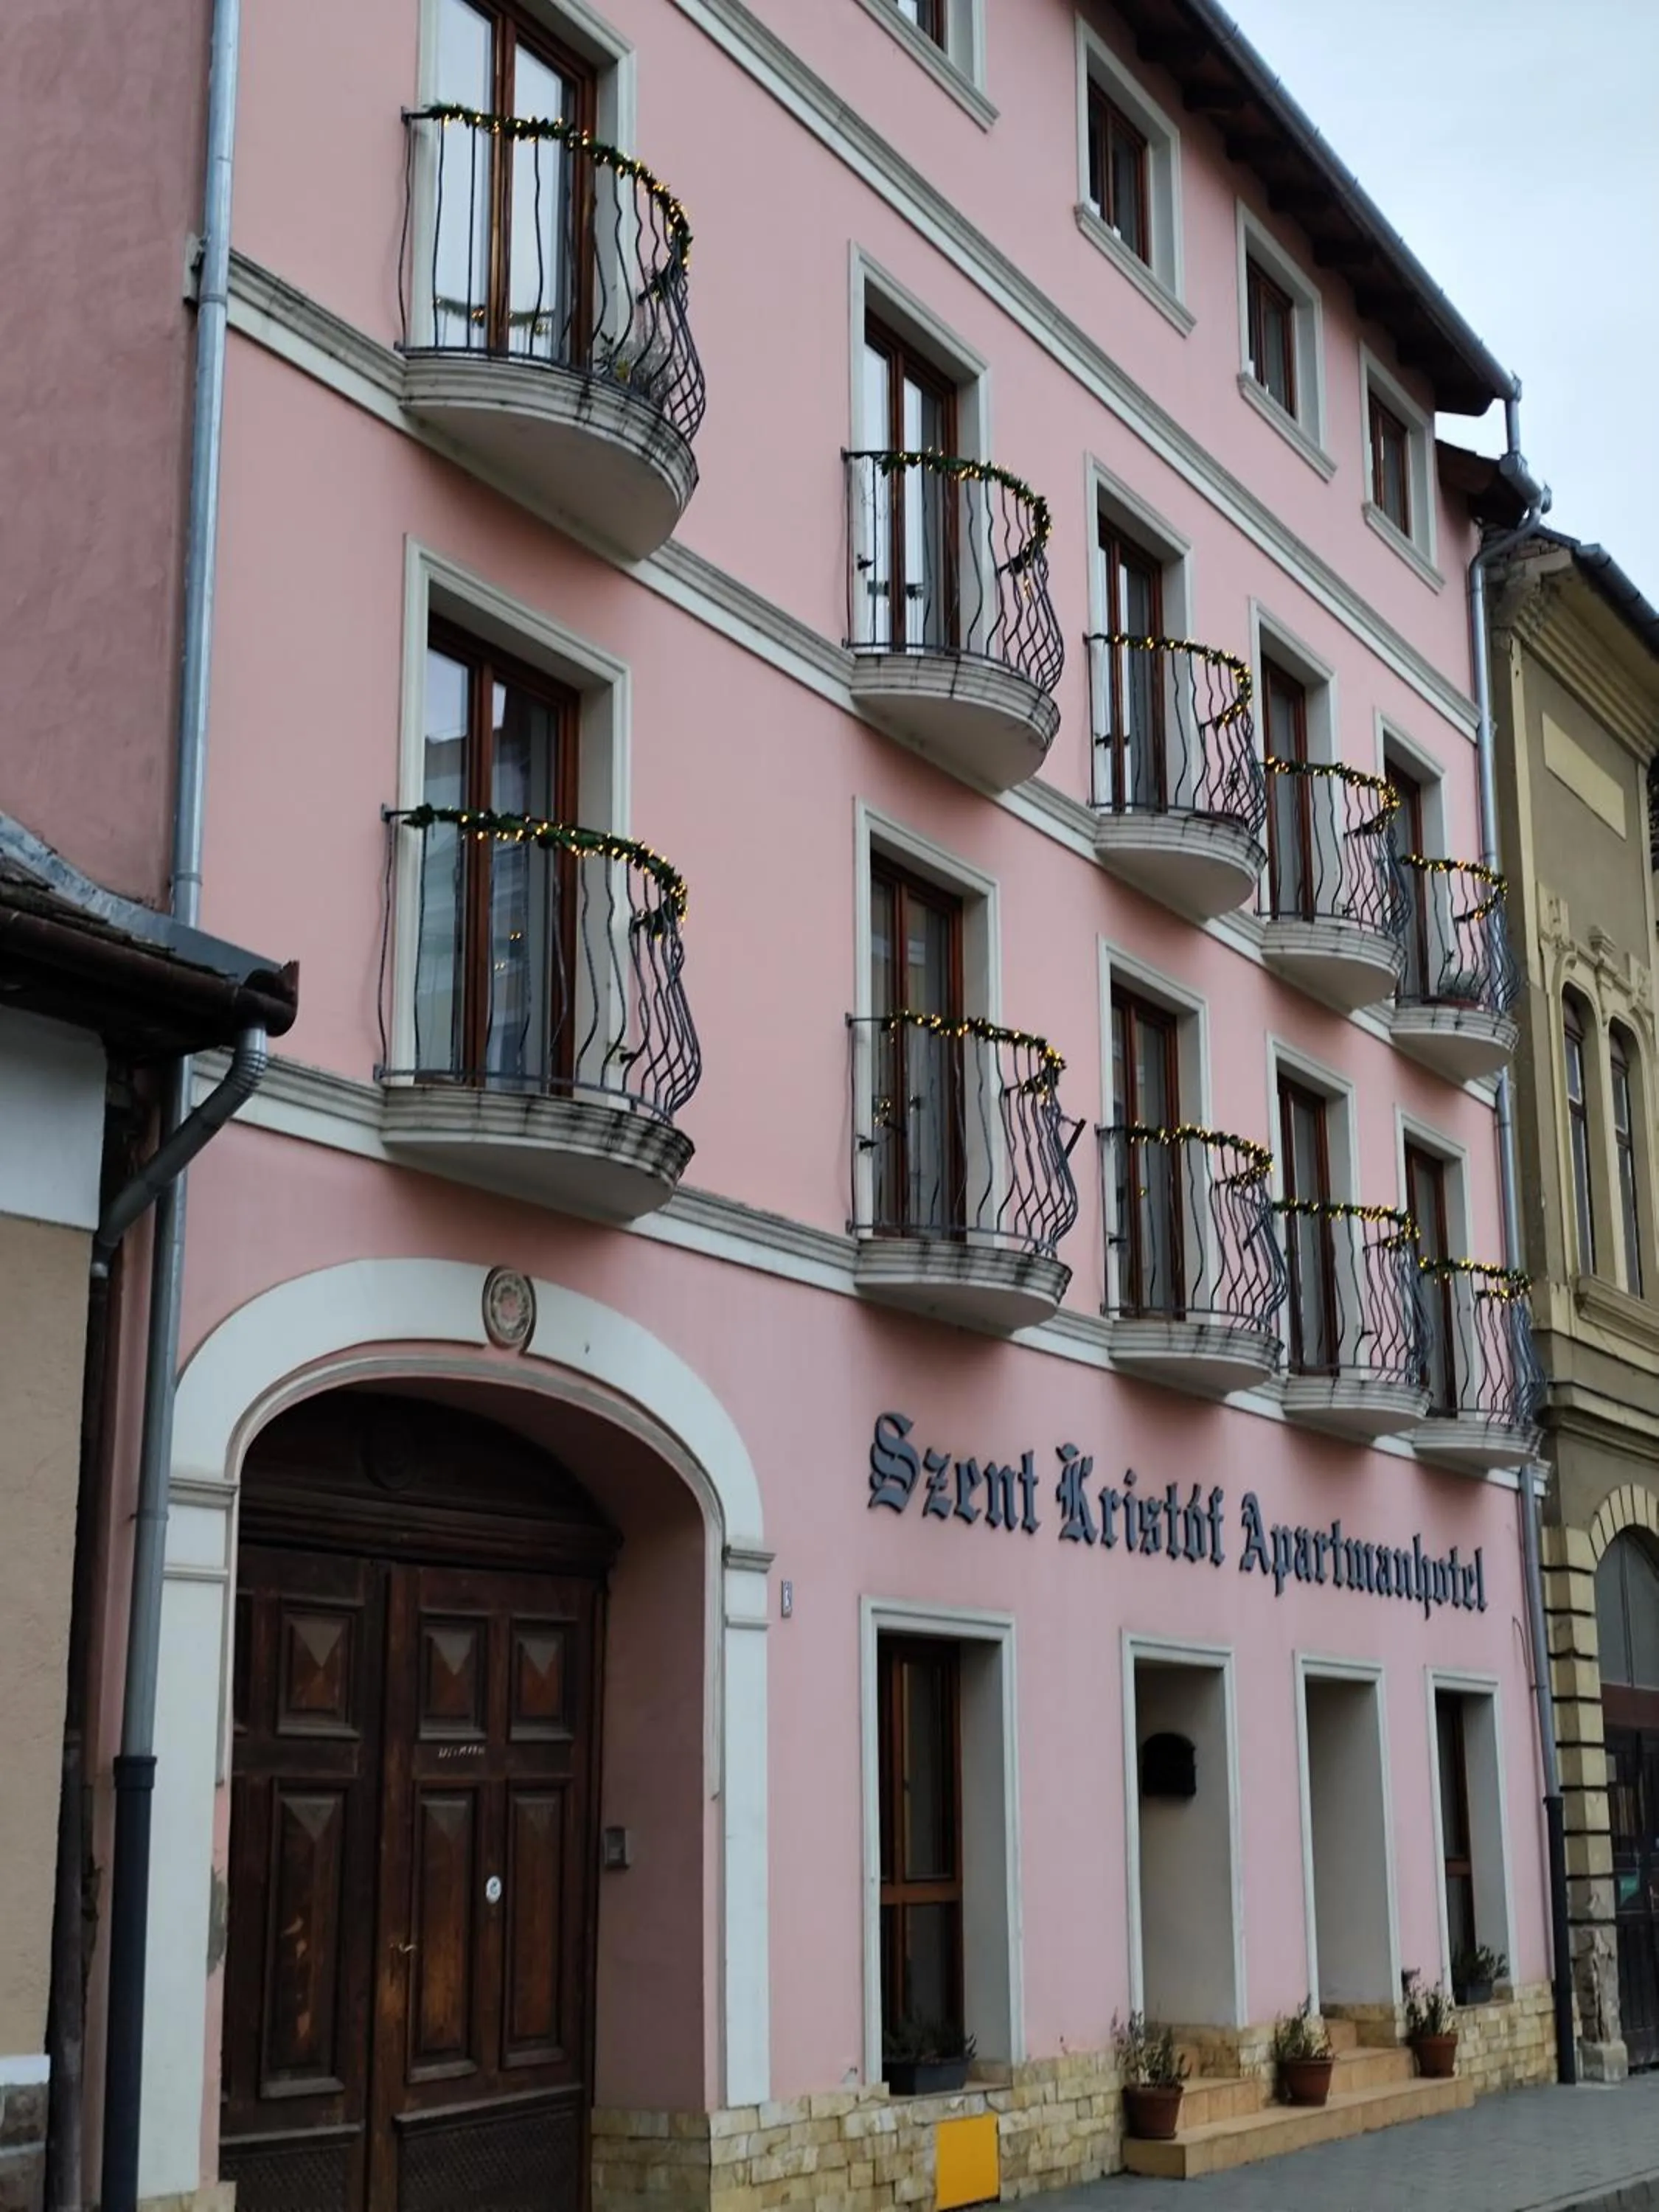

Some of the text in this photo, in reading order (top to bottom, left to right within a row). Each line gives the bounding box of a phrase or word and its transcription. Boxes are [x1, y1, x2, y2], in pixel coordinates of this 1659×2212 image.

[868, 1411, 1488, 1620] Szent Kristóf Apartmanhotel
